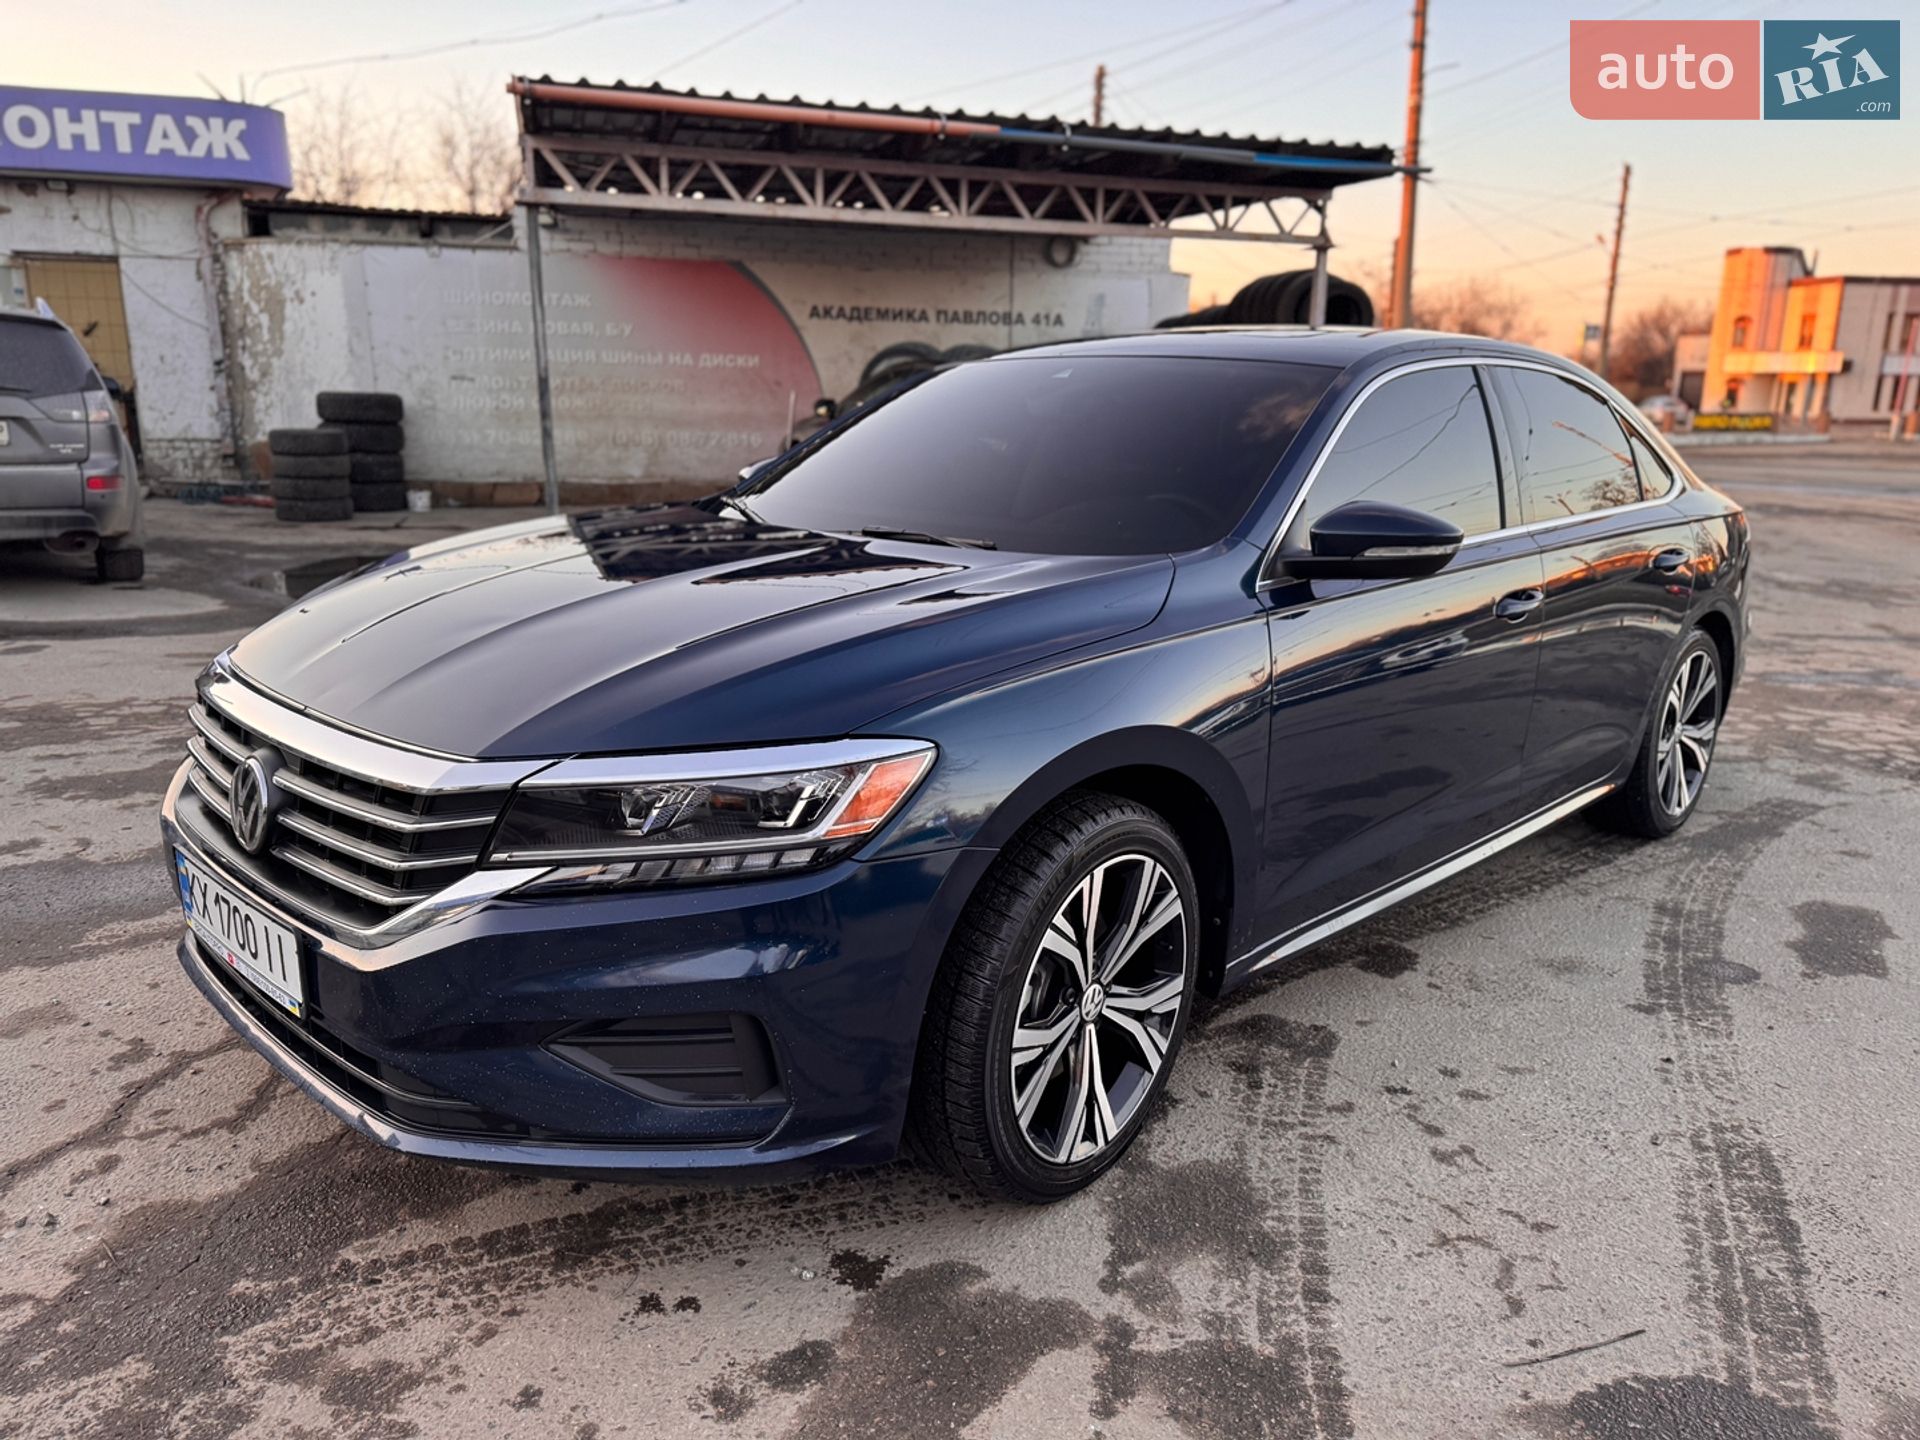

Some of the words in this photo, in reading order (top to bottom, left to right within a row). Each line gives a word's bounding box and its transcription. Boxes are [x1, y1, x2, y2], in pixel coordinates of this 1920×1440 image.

[0, 104, 251, 161] ОНТАЖ
[809, 305, 929, 323] АКАДЕМИКА
[935, 309, 1026, 326] ПАВЛОВА
[1031, 311, 1064, 327] 41А
[669, 352, 694, 367] НА
[699, 352, 761, 369] ДИСКИ
[214, 891, 258, 960] 1700
